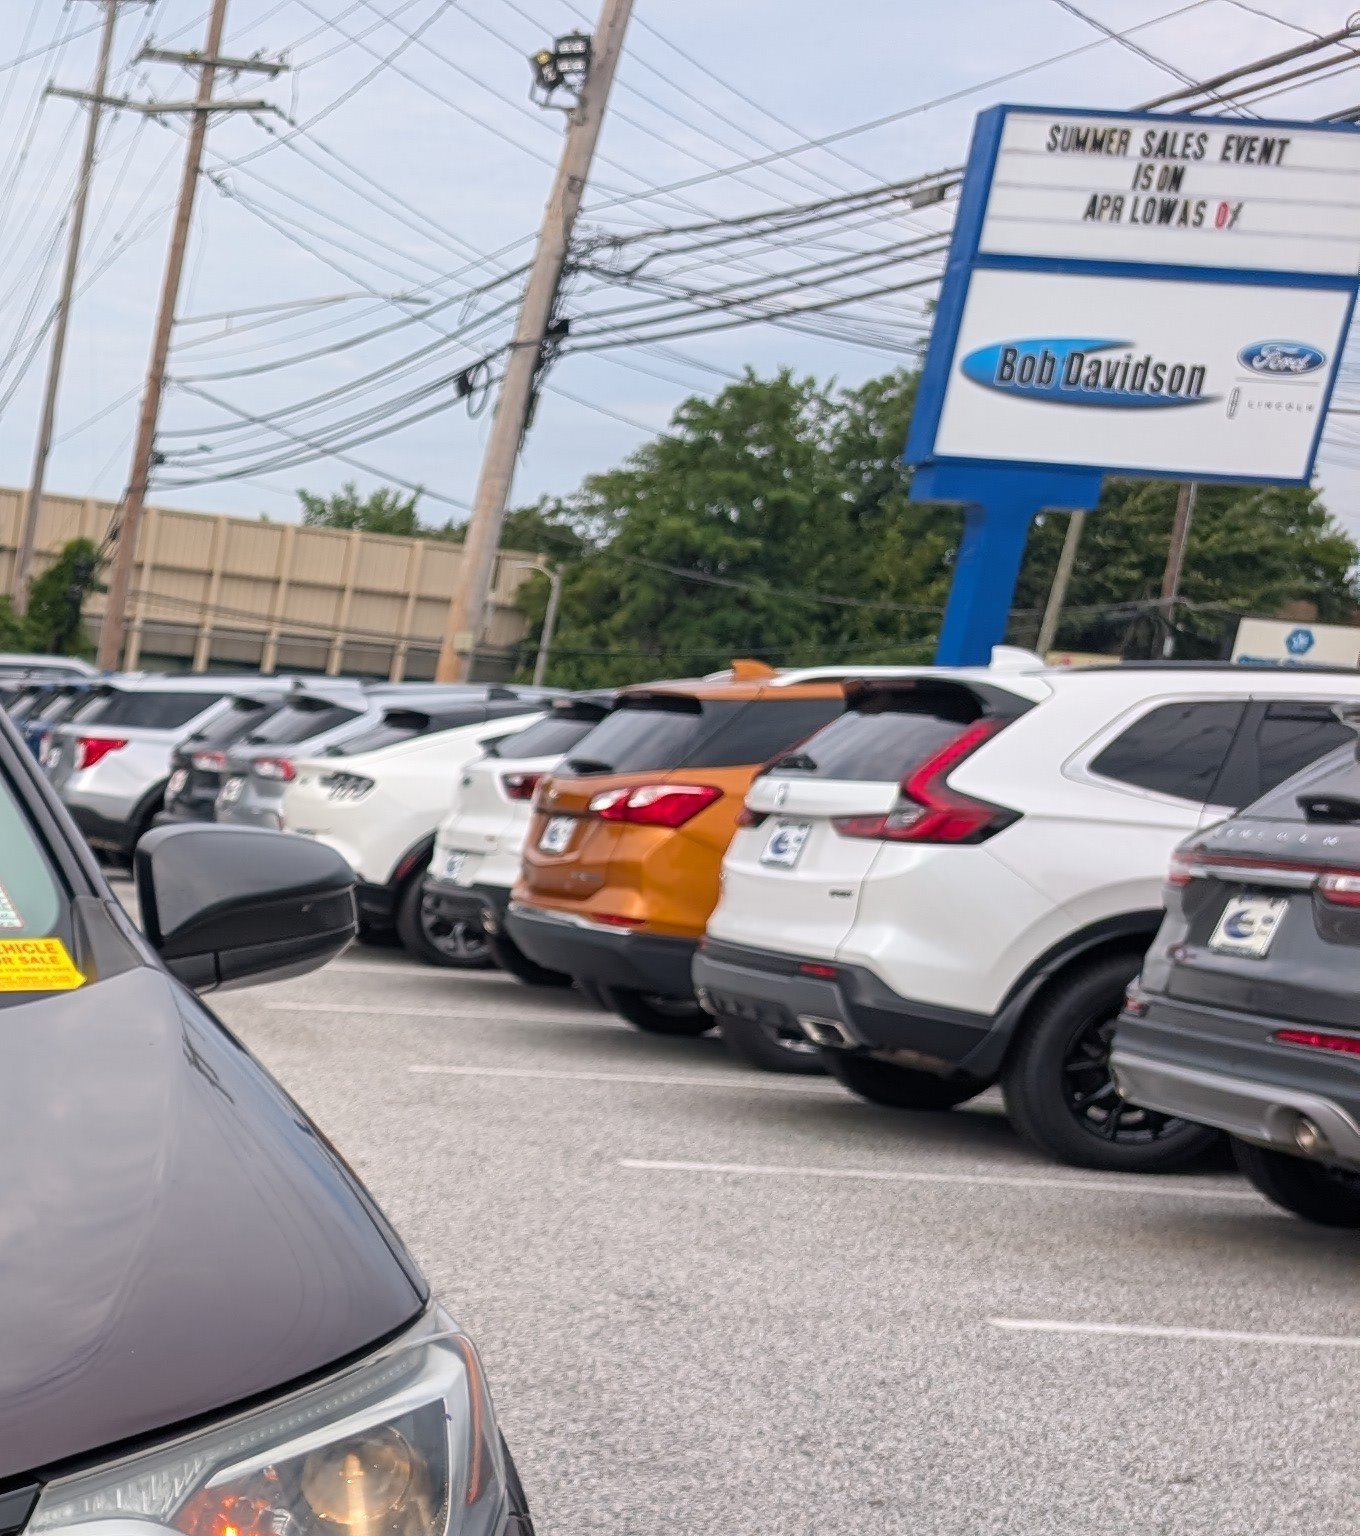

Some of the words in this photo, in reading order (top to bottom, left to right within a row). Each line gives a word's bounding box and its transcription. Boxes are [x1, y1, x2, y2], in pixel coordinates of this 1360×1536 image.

[1046, 123, 1131, 156] SUMMER
[1140, 129, 1209, 160] SALES
[1220, 134, 1290, 166] EVENT
[1131, 162, 1155, 192] IS
[1156, 163, 1186, 194] ON
[1082, 193, 1125, 224] APR
[995, 346, 1057, 386] Bob
[1061, 350, 1208, 399] Davidson
[1252, 344, 1312, 374] Ford
[18, 955, 61, 966] SALE
